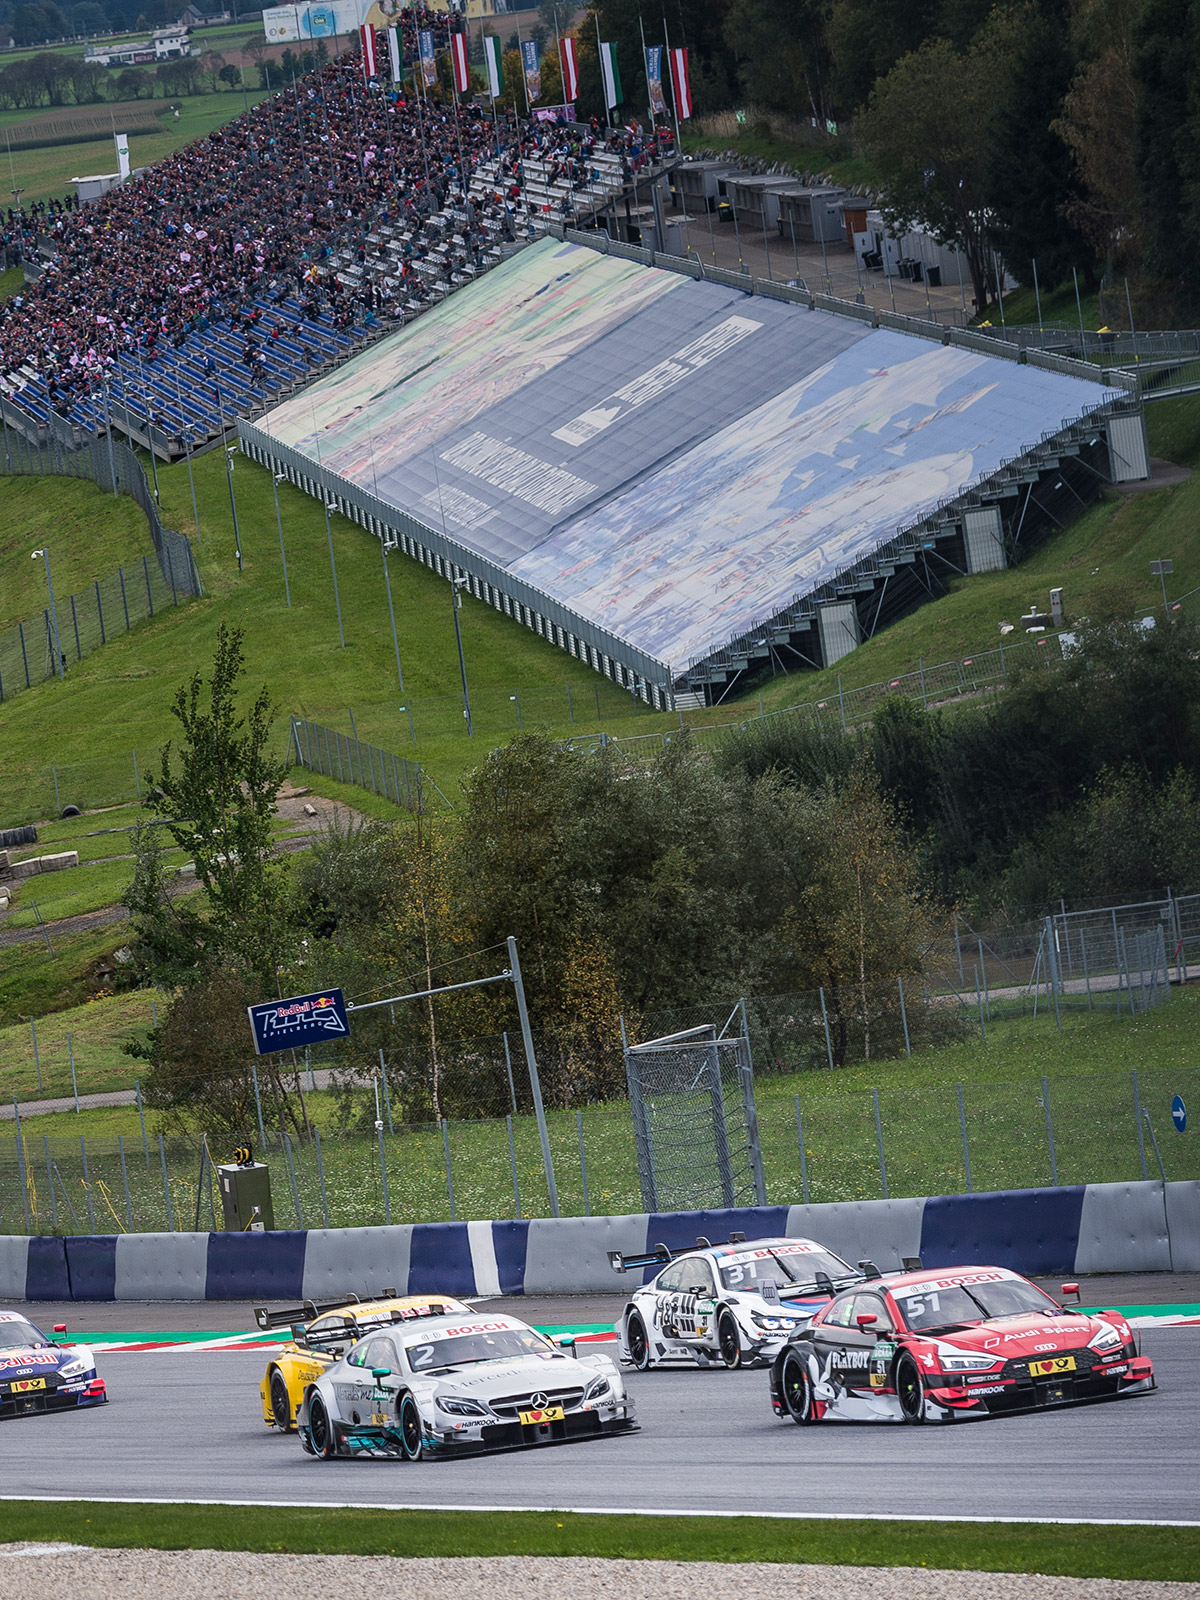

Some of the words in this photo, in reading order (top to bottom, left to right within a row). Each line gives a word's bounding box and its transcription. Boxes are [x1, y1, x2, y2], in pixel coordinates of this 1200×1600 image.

[277, 1004, 295, 1017] Red
[294, 1001, 310, 1013] Bull
[263, 1021, 322, 1038] SPIELBERG
[754, 1246, 811, 1258] BOSCH
[728, 1262, 758, 1284] 31
[937, 1274, 1003, 1288] BOSCH
[400, 1304, 453, 1317] BOSH
[906, 1292, 940, 1318] 51
[446, 1322, 509, 1337] BOSCH
[1004, 1330, 1040, 1342] Audi
[1042, 1326, 1090, 1334] Sport
[19, 1354, 59, 1365] Bull
[415, 1346, 435, 1366] 2
[832, 1352, 870, 1369] PLAYBOY
[876, 1360, 886, 1374] 51
[450, 1368, 537, 1390] Mercedes
